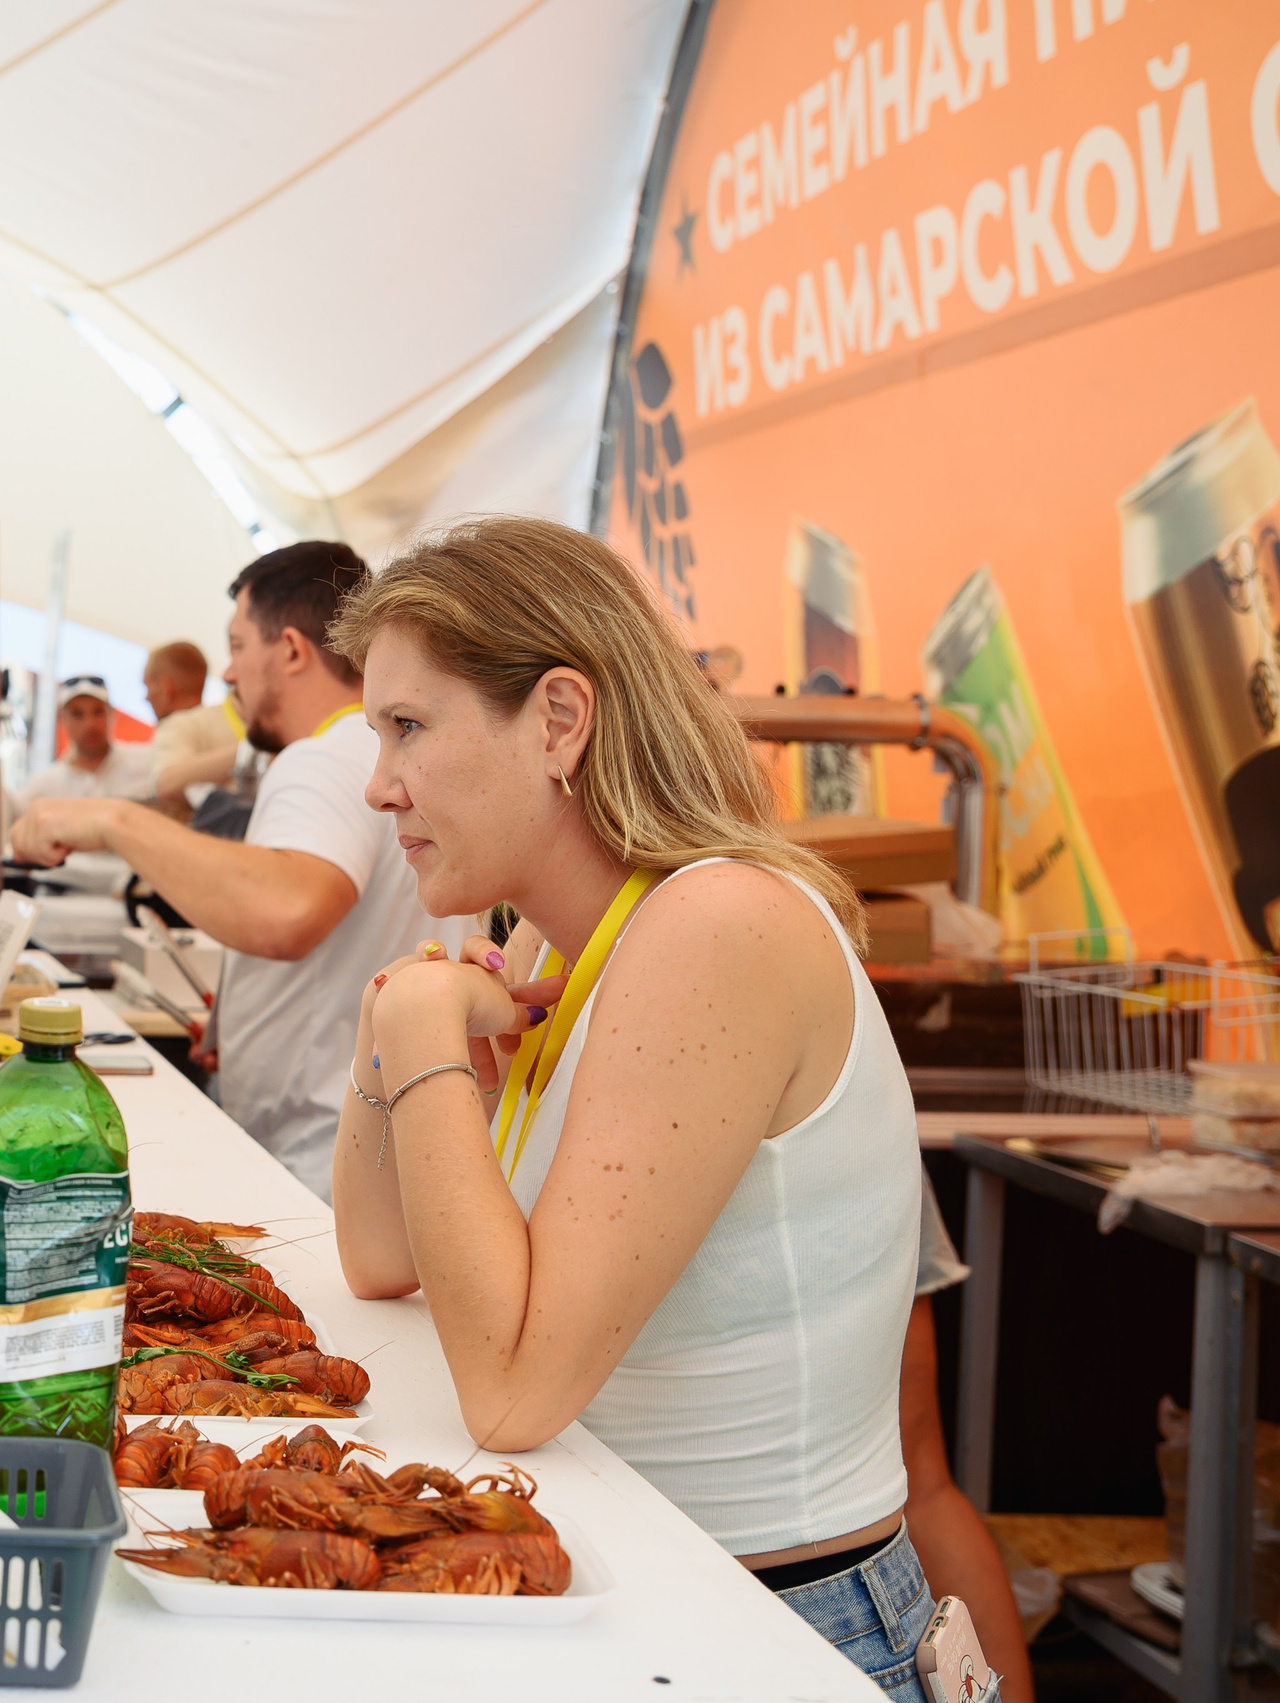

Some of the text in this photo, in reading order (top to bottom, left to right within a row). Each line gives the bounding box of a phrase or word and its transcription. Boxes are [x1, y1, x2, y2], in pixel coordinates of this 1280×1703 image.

[693, 306, 751, 418] ИЗ
[758, 42, 1221, 391] САМАРСКОЙ
[707, 0, 1009, 254] СЕМЕЙНАЯ
